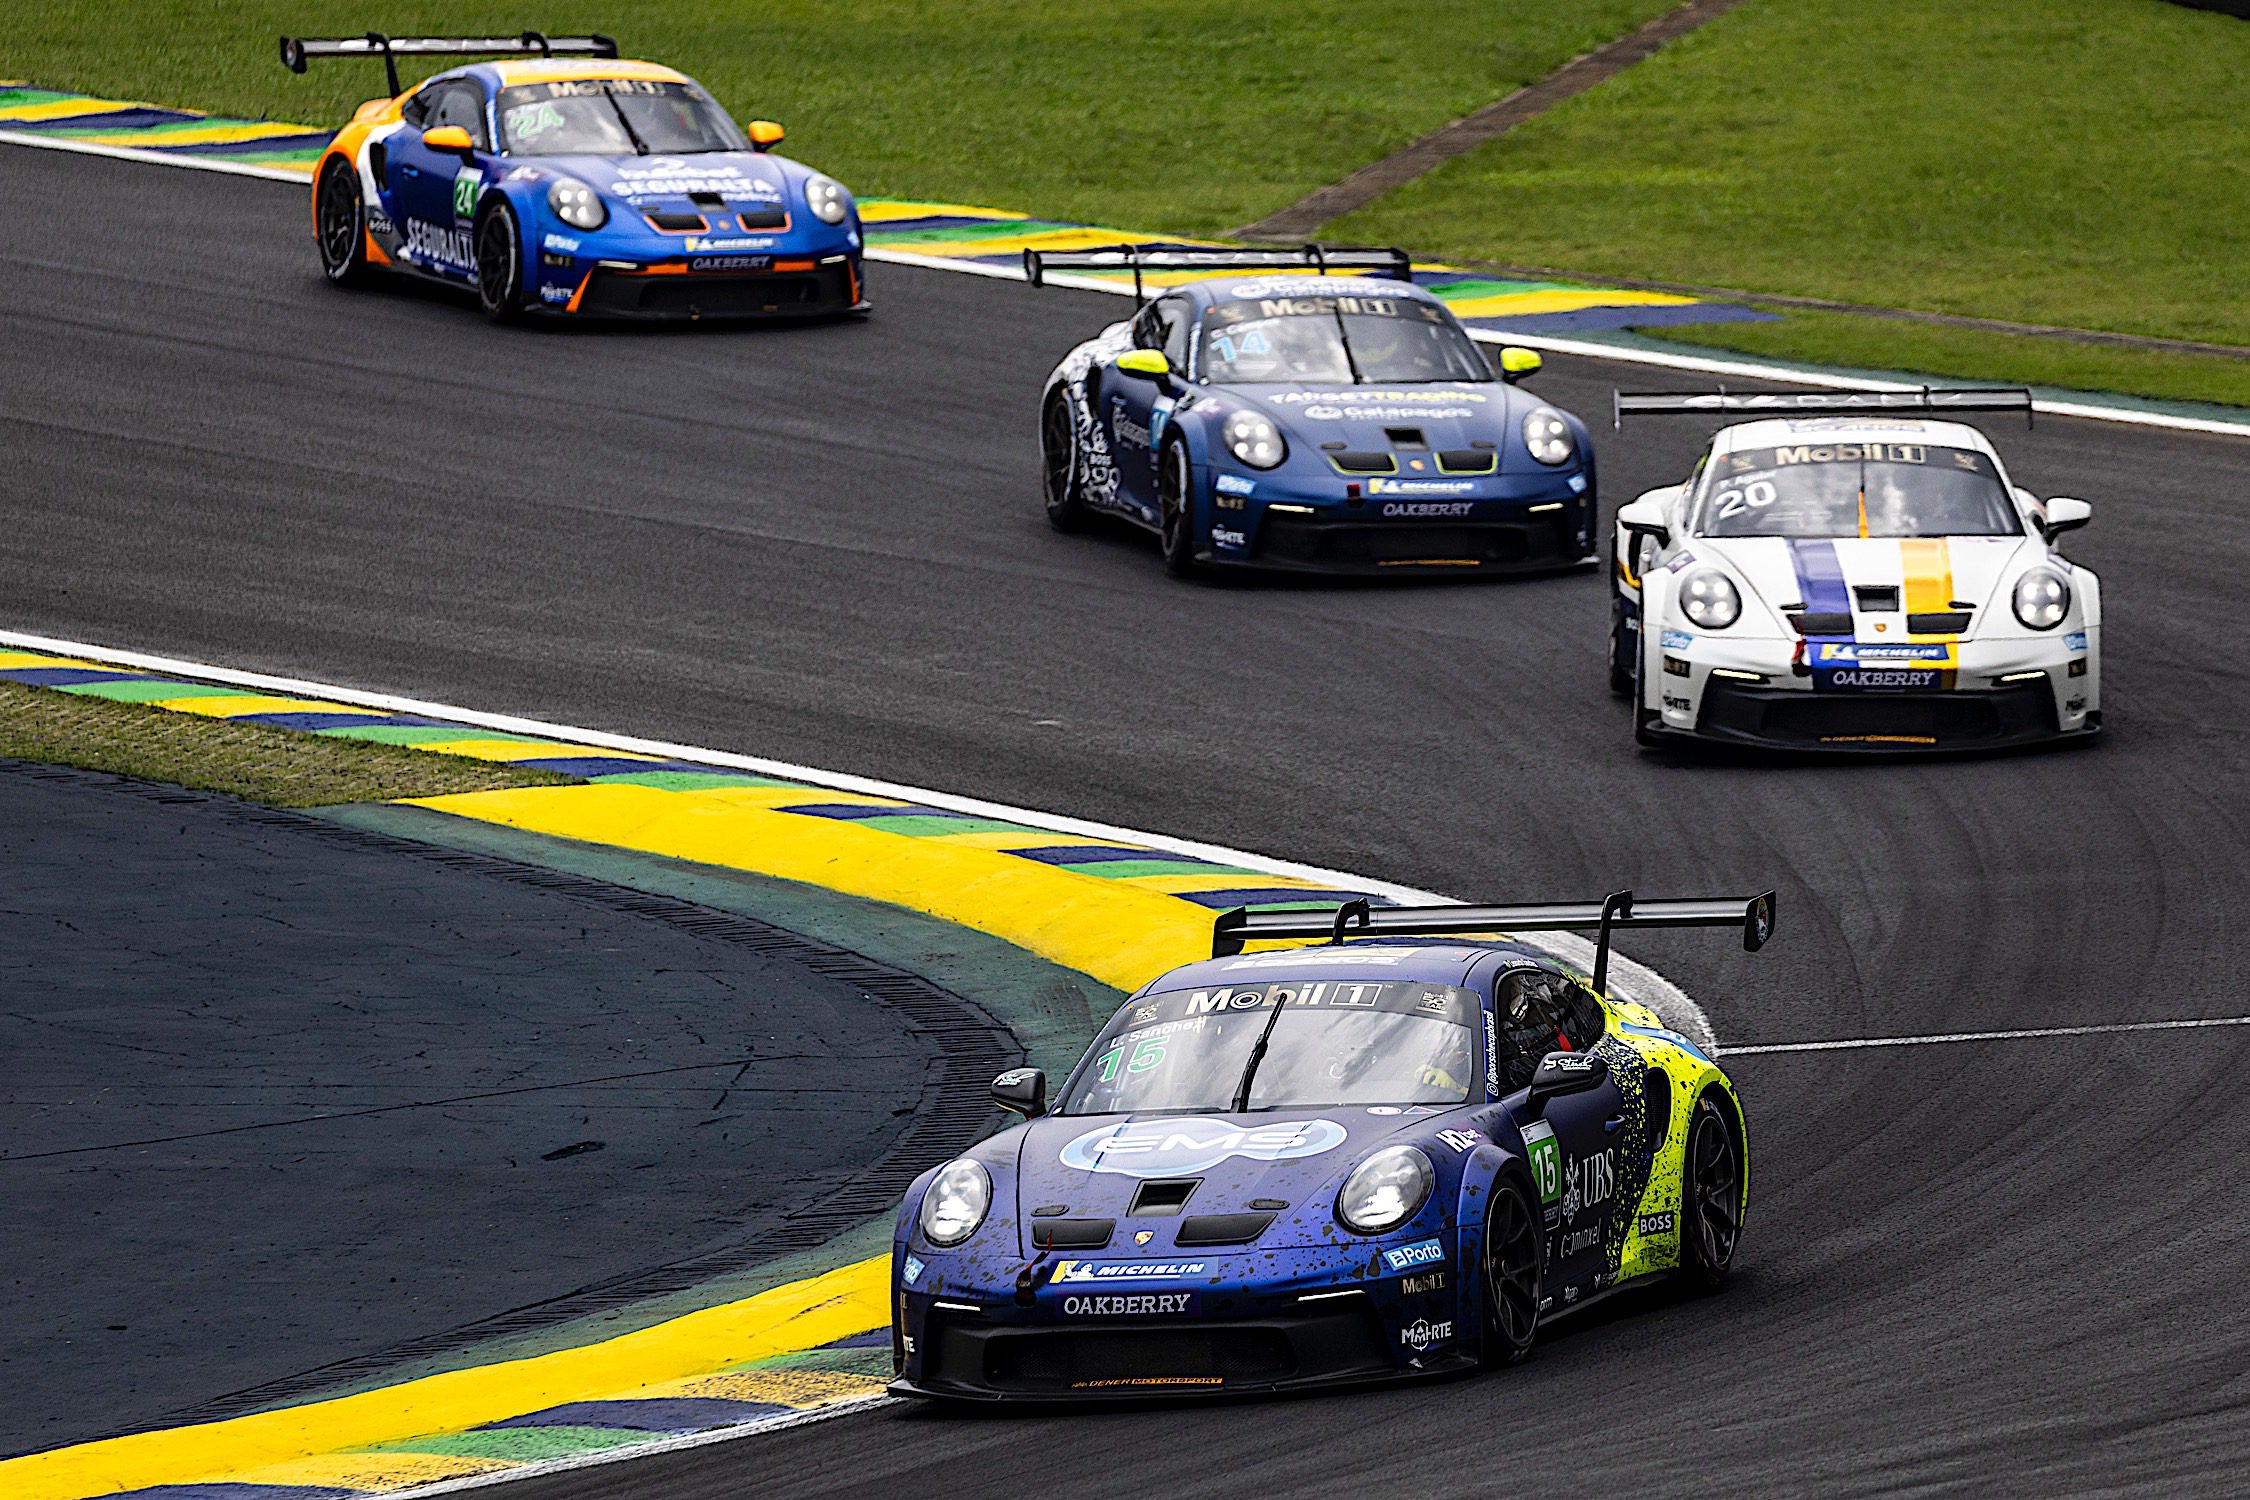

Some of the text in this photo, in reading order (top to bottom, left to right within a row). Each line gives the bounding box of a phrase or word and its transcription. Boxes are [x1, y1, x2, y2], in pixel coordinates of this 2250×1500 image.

[456, 181, 473, 213] 24
[693, 256, 770, 269] OAKBERRY
[1210, 331, 1271, 362] 14
[1776, 443, 1882, 465] Mobil
[1383, 503, 1473, 516] OAKBERRY
[1715, 481, 1777, 519] 20
[1857, 648, 1939, 657] MICHELIN
[1833, 671, 1934, 685] OAKBERRY
[1184, 982, 1328, 1016] Mobil
[1096, 1035, 1169, 1083] 15
[1093, 1130, 1311, 1154] EMS
[1535, 1145, 1556, 1197] 15
[1583, 1148, 1614, 1207] UBS
[1640, 1214, 1672, 1233] BOSS
[1404, 1244, 1441, 1263] Porto
[1098, 1263, 1204, 1276] MICHELIN
[1403, 1275, 1436, 1294] Mobil
[1064, 1294, 1190, 1314] OAKBERRY
[1089, 1378, 1130, 1387] DENER
